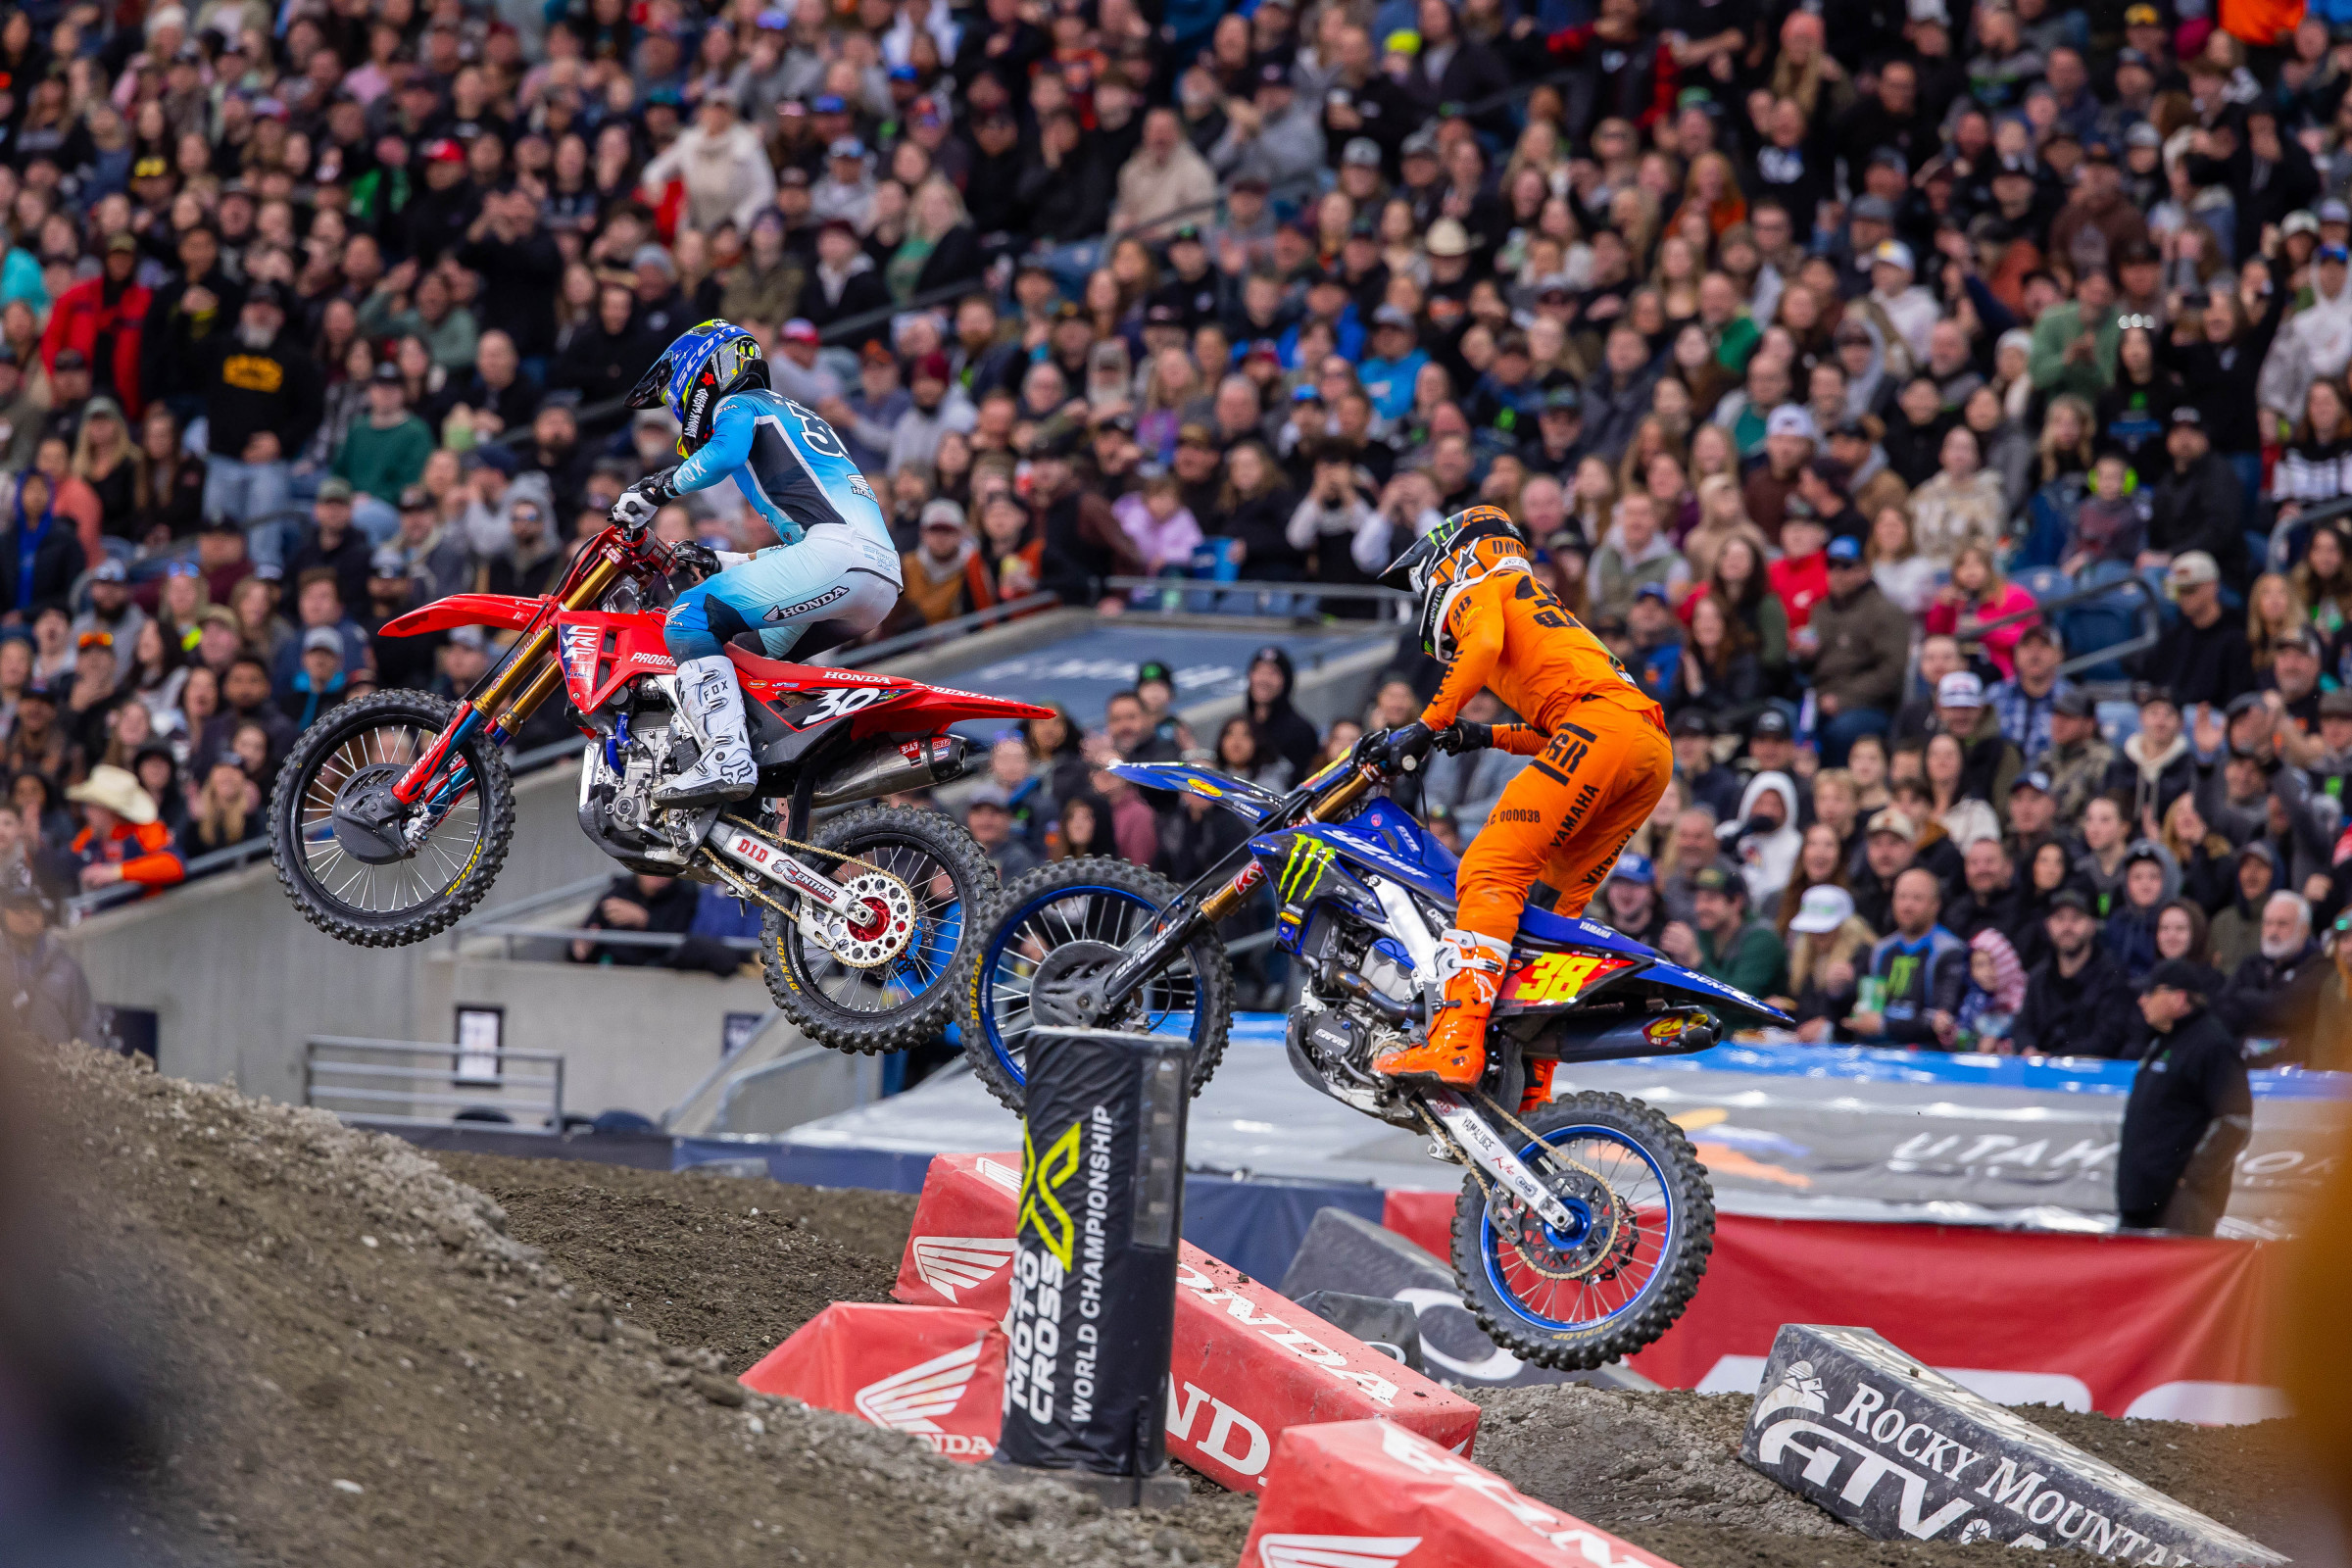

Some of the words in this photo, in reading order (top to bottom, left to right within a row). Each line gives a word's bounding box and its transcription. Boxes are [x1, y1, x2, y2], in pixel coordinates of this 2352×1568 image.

[673, 459, 708, 488] FOX
[853, 486, 879, 505] HOND
[781, 586, 851, 619] HONDA
[629, 652, 678, 666] PROGR
[822, 671, 891, 685] HONDA
[704, 680, 728, 701] FOX
[802, 687, 880, 725] 30
[401, 724, 452, 786] DUNLOP
[1549, 784, 1599, 849] YAMAHA
[445, 843, 483, 897] DUNLOP
[737, 838, 768, 863] D.I.D
[1233, 859, 1266, 895] KY
[776, 936, 801, 992] DUNLOP
[1115, 918, 1178, 978] DUNLOP
[969, 953, 984, 1021] DUNLOP
[1514, 952, 1603, 1004] 38
[1079, 1104, 1114, 1320] CHAMPIONSHIP
[1011, 1250, 1040, 1409] MOTO
[1030, 1250, 1064, 1425] CROSS
[1070, 1323, 1099, 1424] WORLD
[921, 1434, 996, 1457] NDA
[1832, 1382, 1985, 1484] ROCKY
